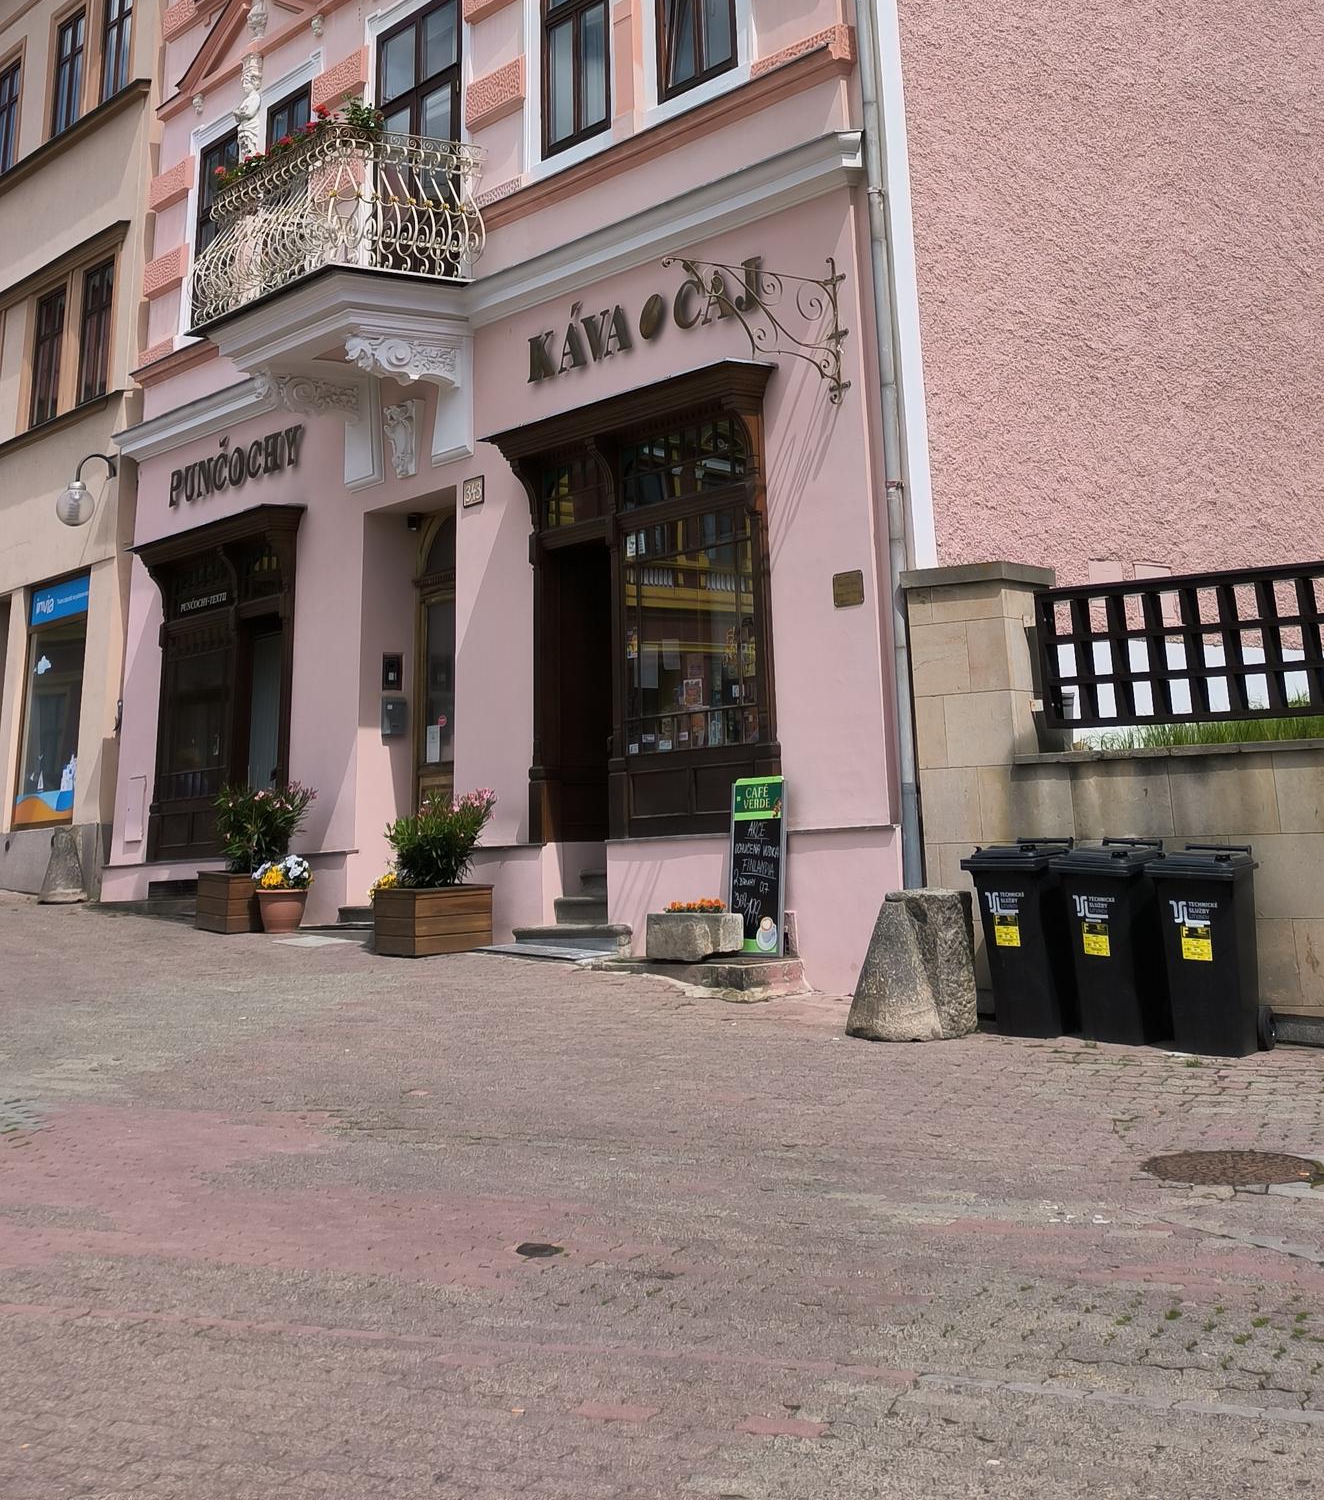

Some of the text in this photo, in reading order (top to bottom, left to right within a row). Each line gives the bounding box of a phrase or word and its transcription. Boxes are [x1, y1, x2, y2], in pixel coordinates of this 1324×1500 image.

[527, 256, 762, 383] KÁVA ČAJ
[169, 424, 303, 508] PUNČOCHY
[36, 594, 54, 614] invia
[745, 784, 769, 799] CAFÉ
[743, 798, 770, 809] VERDE
